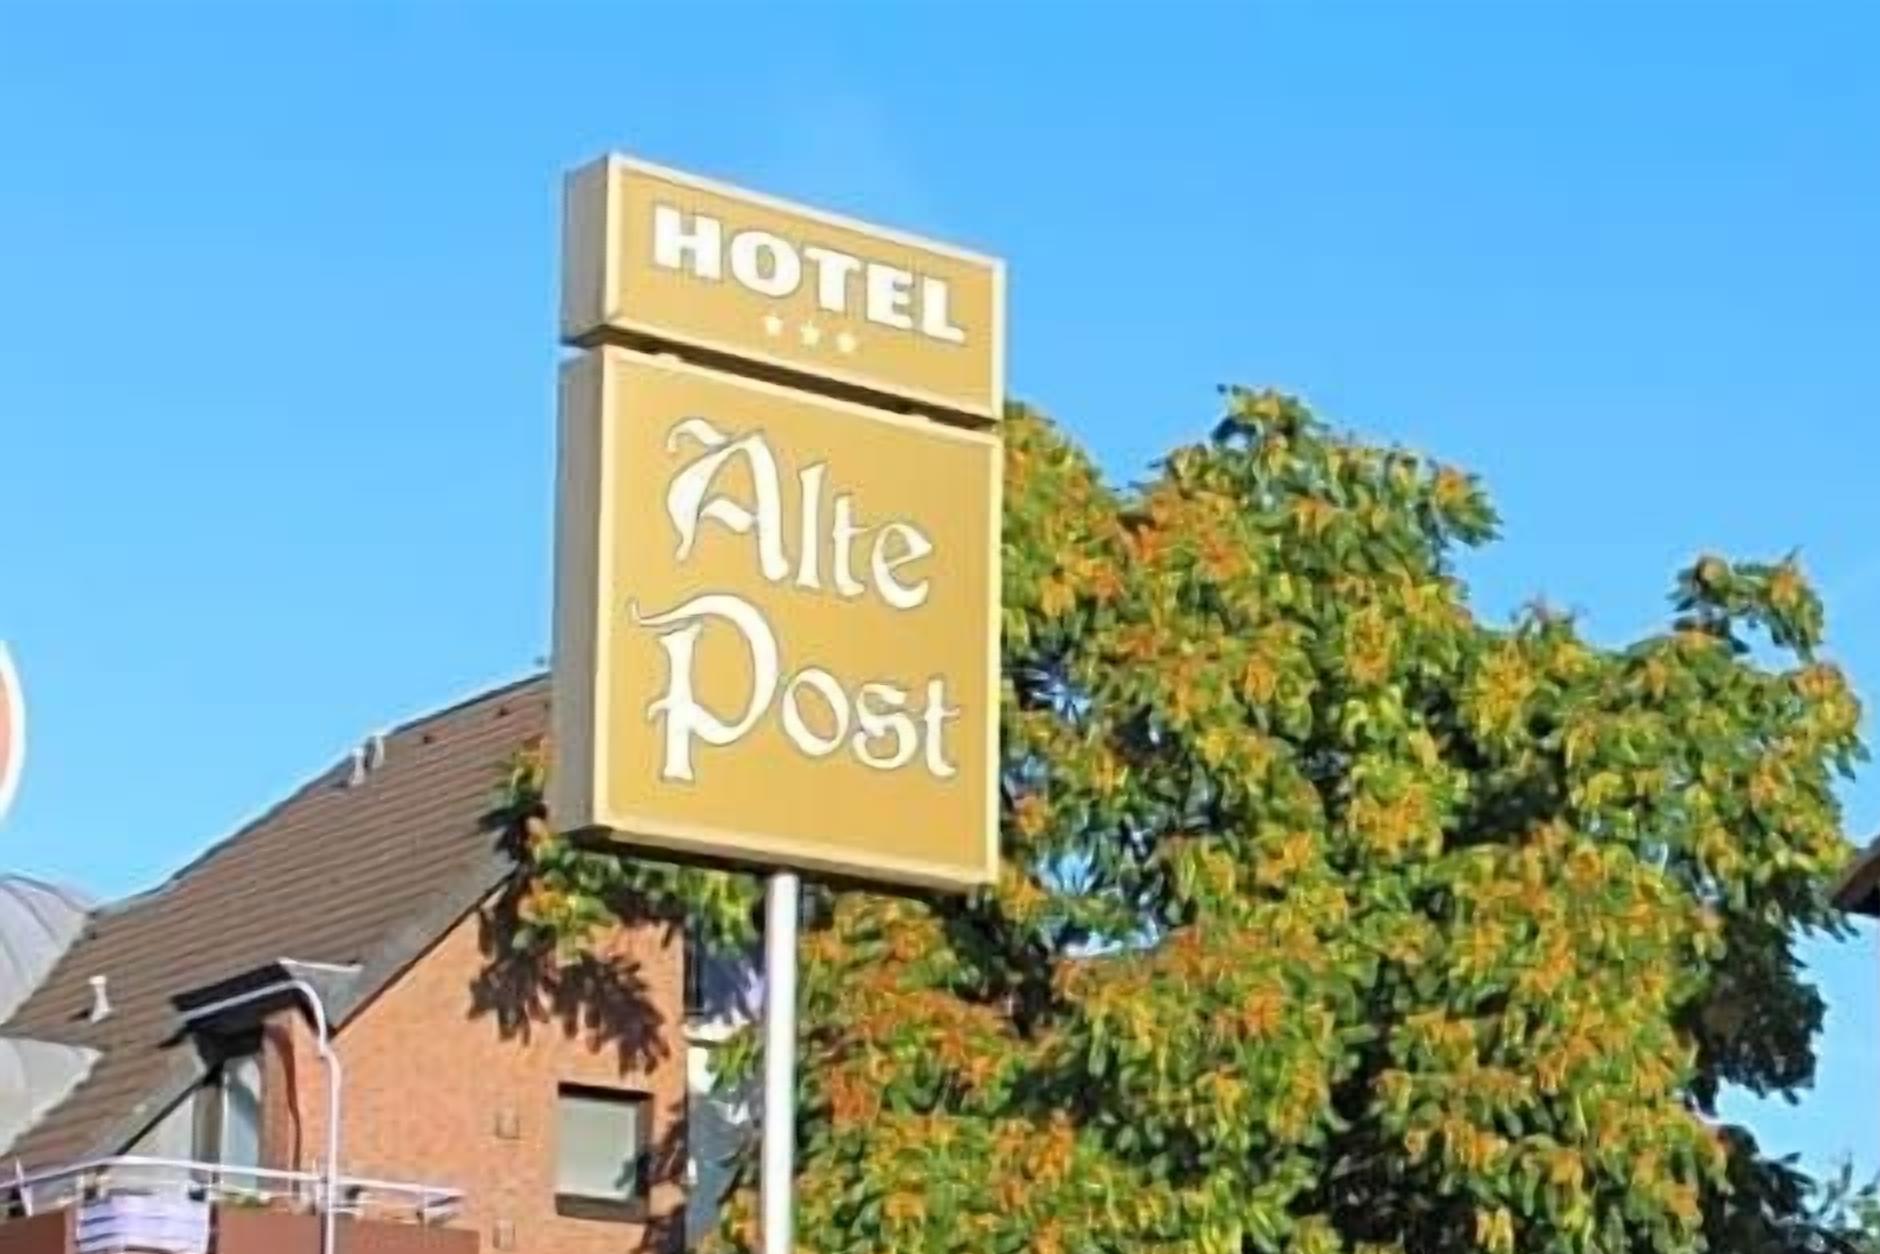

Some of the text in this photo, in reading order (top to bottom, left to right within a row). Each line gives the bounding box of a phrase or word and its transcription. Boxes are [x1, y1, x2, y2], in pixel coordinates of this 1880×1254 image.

[652, 205, 967, 344] HOTEL
[664, 416, 934, 611] Alte
[631, 593, 961, 783] Post
